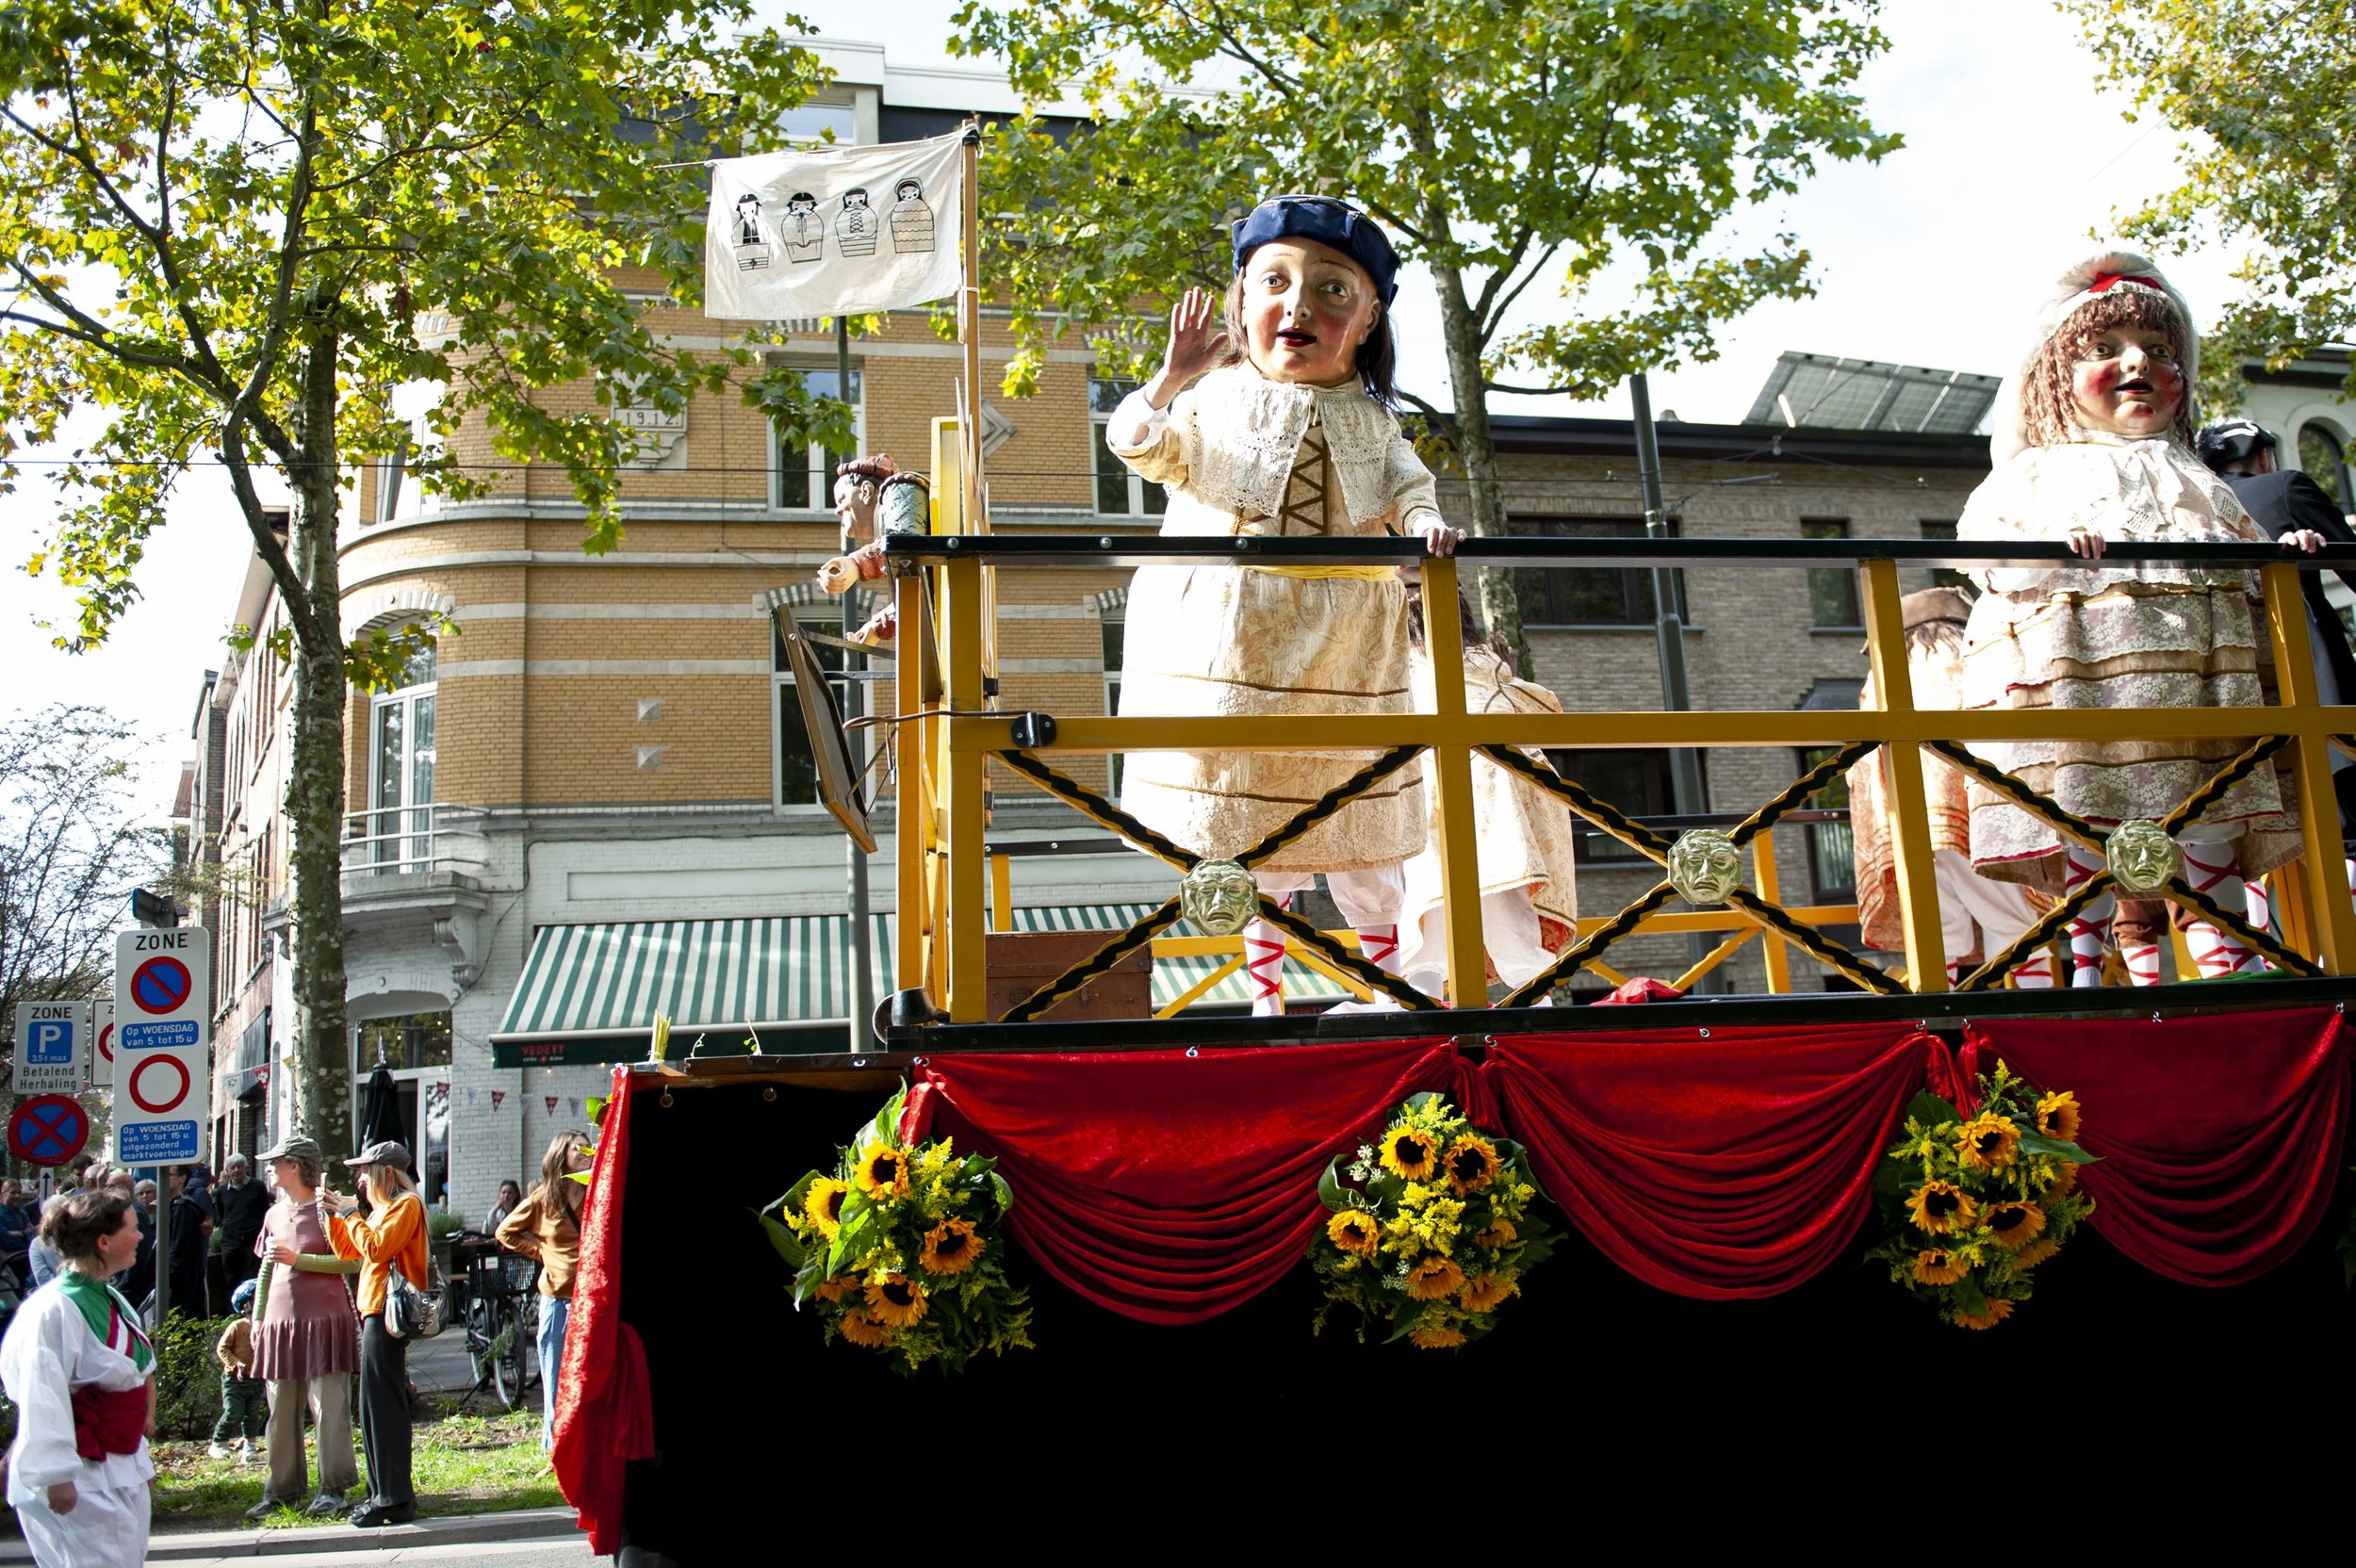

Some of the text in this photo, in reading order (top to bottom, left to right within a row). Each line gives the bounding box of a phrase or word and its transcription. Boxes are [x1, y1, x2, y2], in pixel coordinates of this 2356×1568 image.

[135, 932, 188, 951] ZONE
[31, 1006, 73, 1019] ZONE
[126, 1023, 194, 1037] Op WOENSDAG
[39, 1025, 61, 1054] P
[147, 1037, 154, 1045] 5
[157, 1036, 172, 1045] tot
[175, 1034, 185, 1043] 15
[521, 1043, 564, 1055] VEDETT
[23, 1066, 75, 1076] Betalend
[20, 1078, 77, 1090] Herhaling
[123, 1122, 191, 1135] Op WOENSDAG
[154, 1133, 167, 1141] tot
[123, 1140, 180, 1152] uitgezonderd
[123, 1149, 195, 1160] marktvoertuigen
